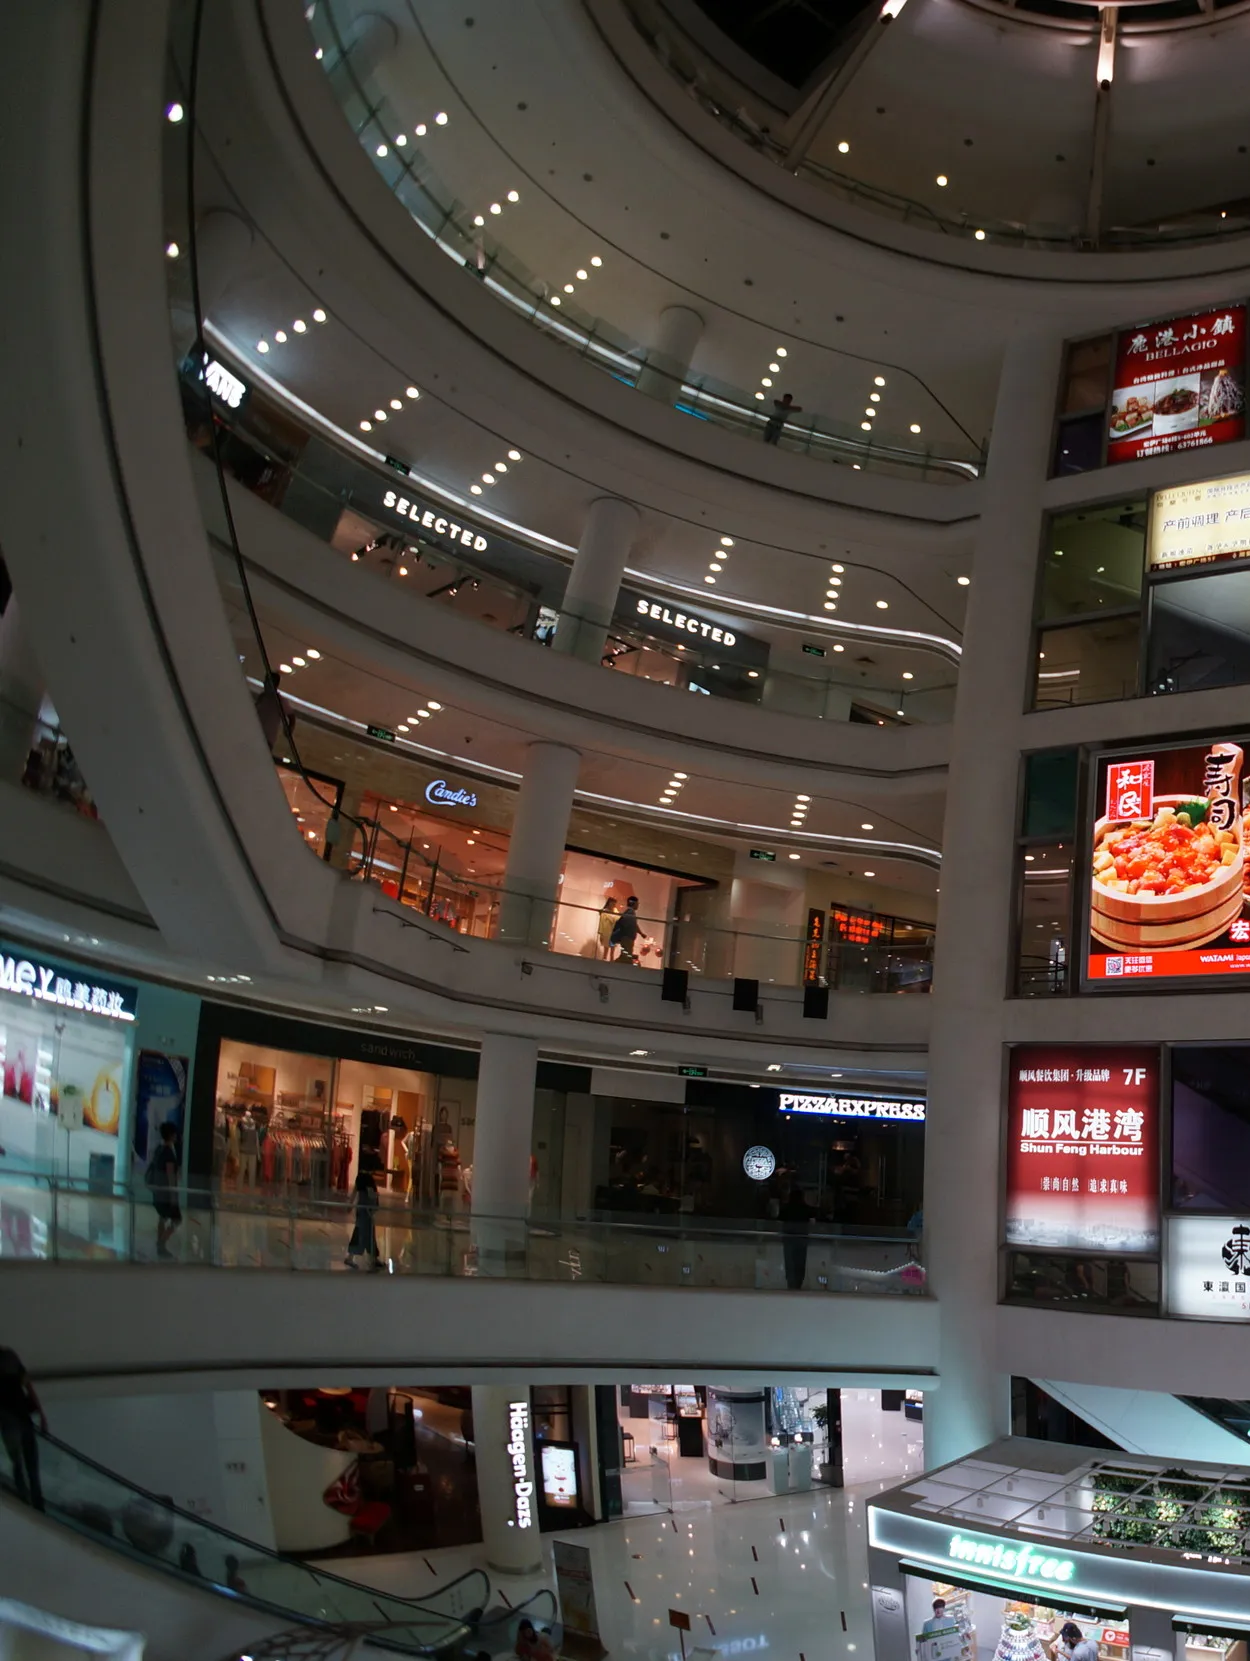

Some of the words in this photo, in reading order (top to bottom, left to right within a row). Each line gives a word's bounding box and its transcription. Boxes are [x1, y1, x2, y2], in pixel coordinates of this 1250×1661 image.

[1145, 339, 1218, 361] BELLAGIO
[383, 491, 488, 552] SELECTED
[1162, 512, 1220, 532] 产前调理
[637, 599, 736, 646] SELECTED
[425, 780, 477, 806] Candie's
[1116, 768, 1142, 817] 和民
[1203, 753, 1237, 831] 寿司
[1122, 1068, 1146, 1085] 7F
[1021, 1107, 1144, 1141] 顺风港湾
[1020, 1143, 1053, 1153] Shun
[1055, 1144, 1087, 1156] Feng
[1089, 1144, 1144, 1156] Harbour
[507, 1402, 533, 1529] Häagen-Dazs
[949, 1534, 1076, 1581] innisfree
